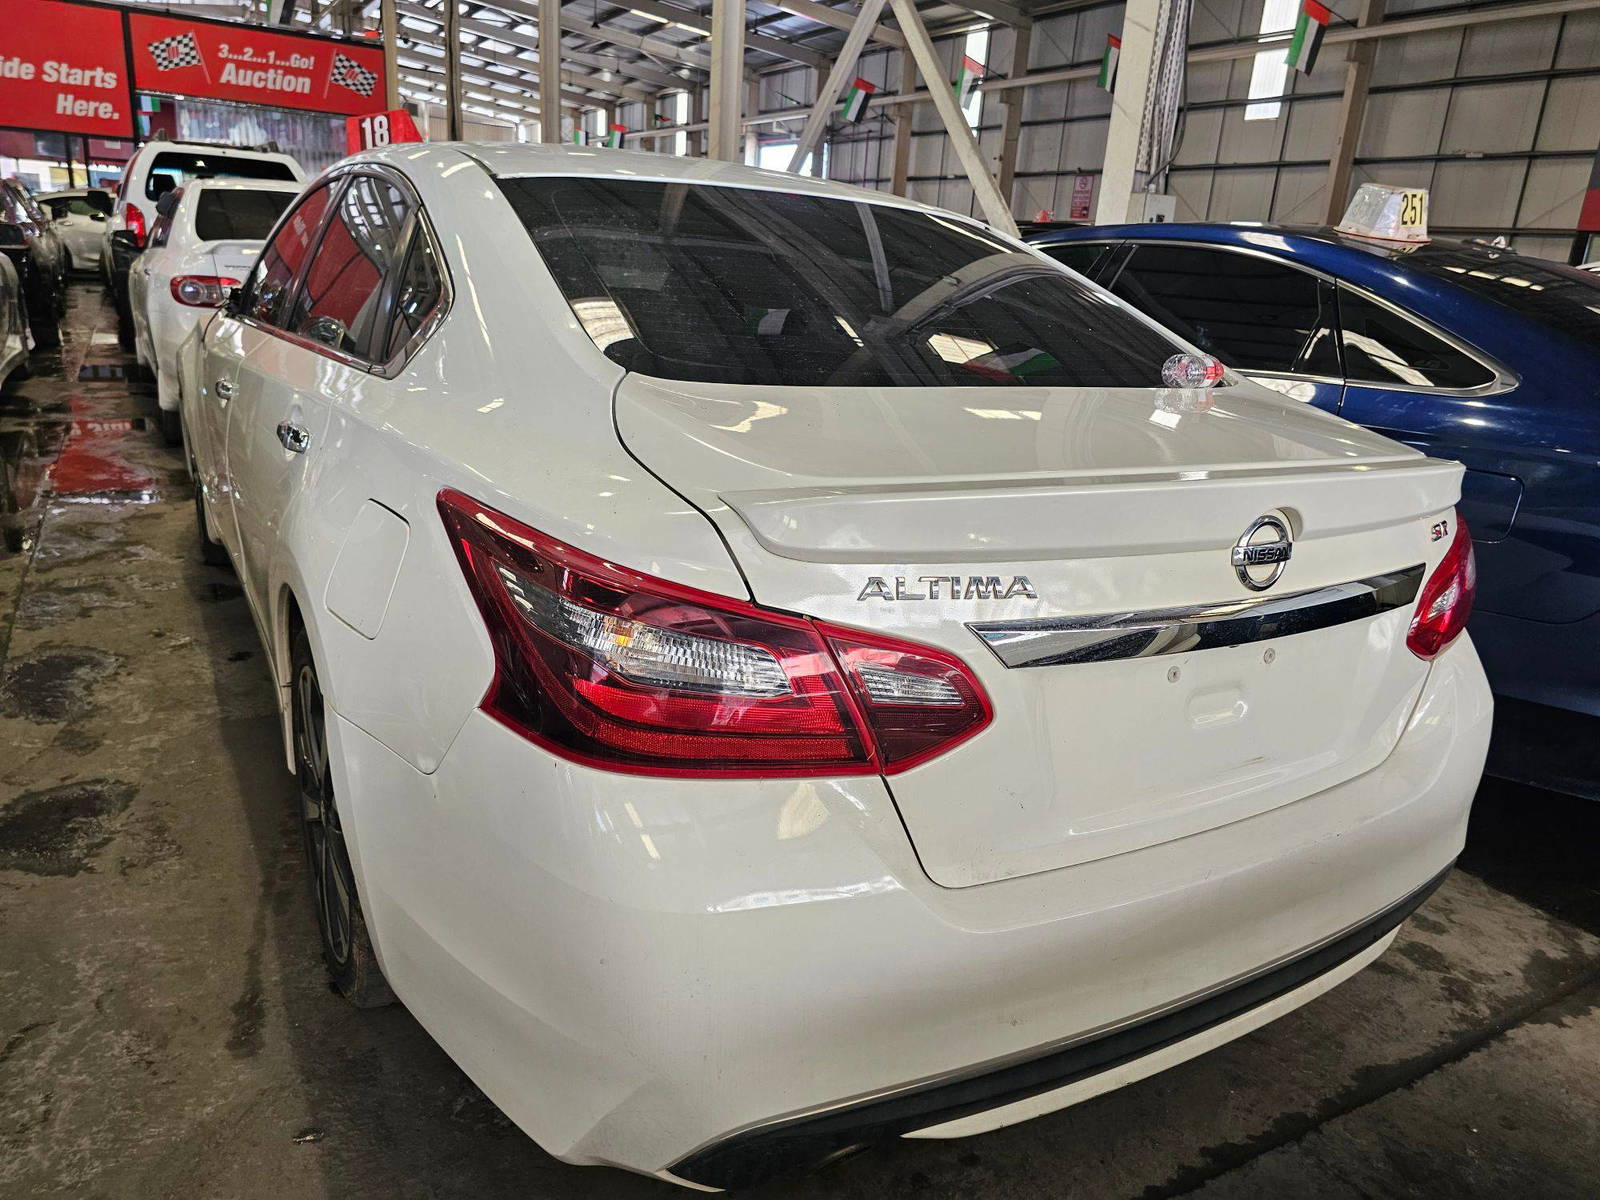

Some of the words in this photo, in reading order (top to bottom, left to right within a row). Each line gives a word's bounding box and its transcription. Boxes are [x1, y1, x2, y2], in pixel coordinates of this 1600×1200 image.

[42, 60, 117, 88] Starts
[219, 62, 311, 94] Auction
[56, 93, 119, 119] Here.
[361, 115, 389, 149] 18
[1401, 193, 1423, 225] 251
[1243, 546, 1289, 562] NISSAN
[857, 575, 1038, 601] ALTIMA
